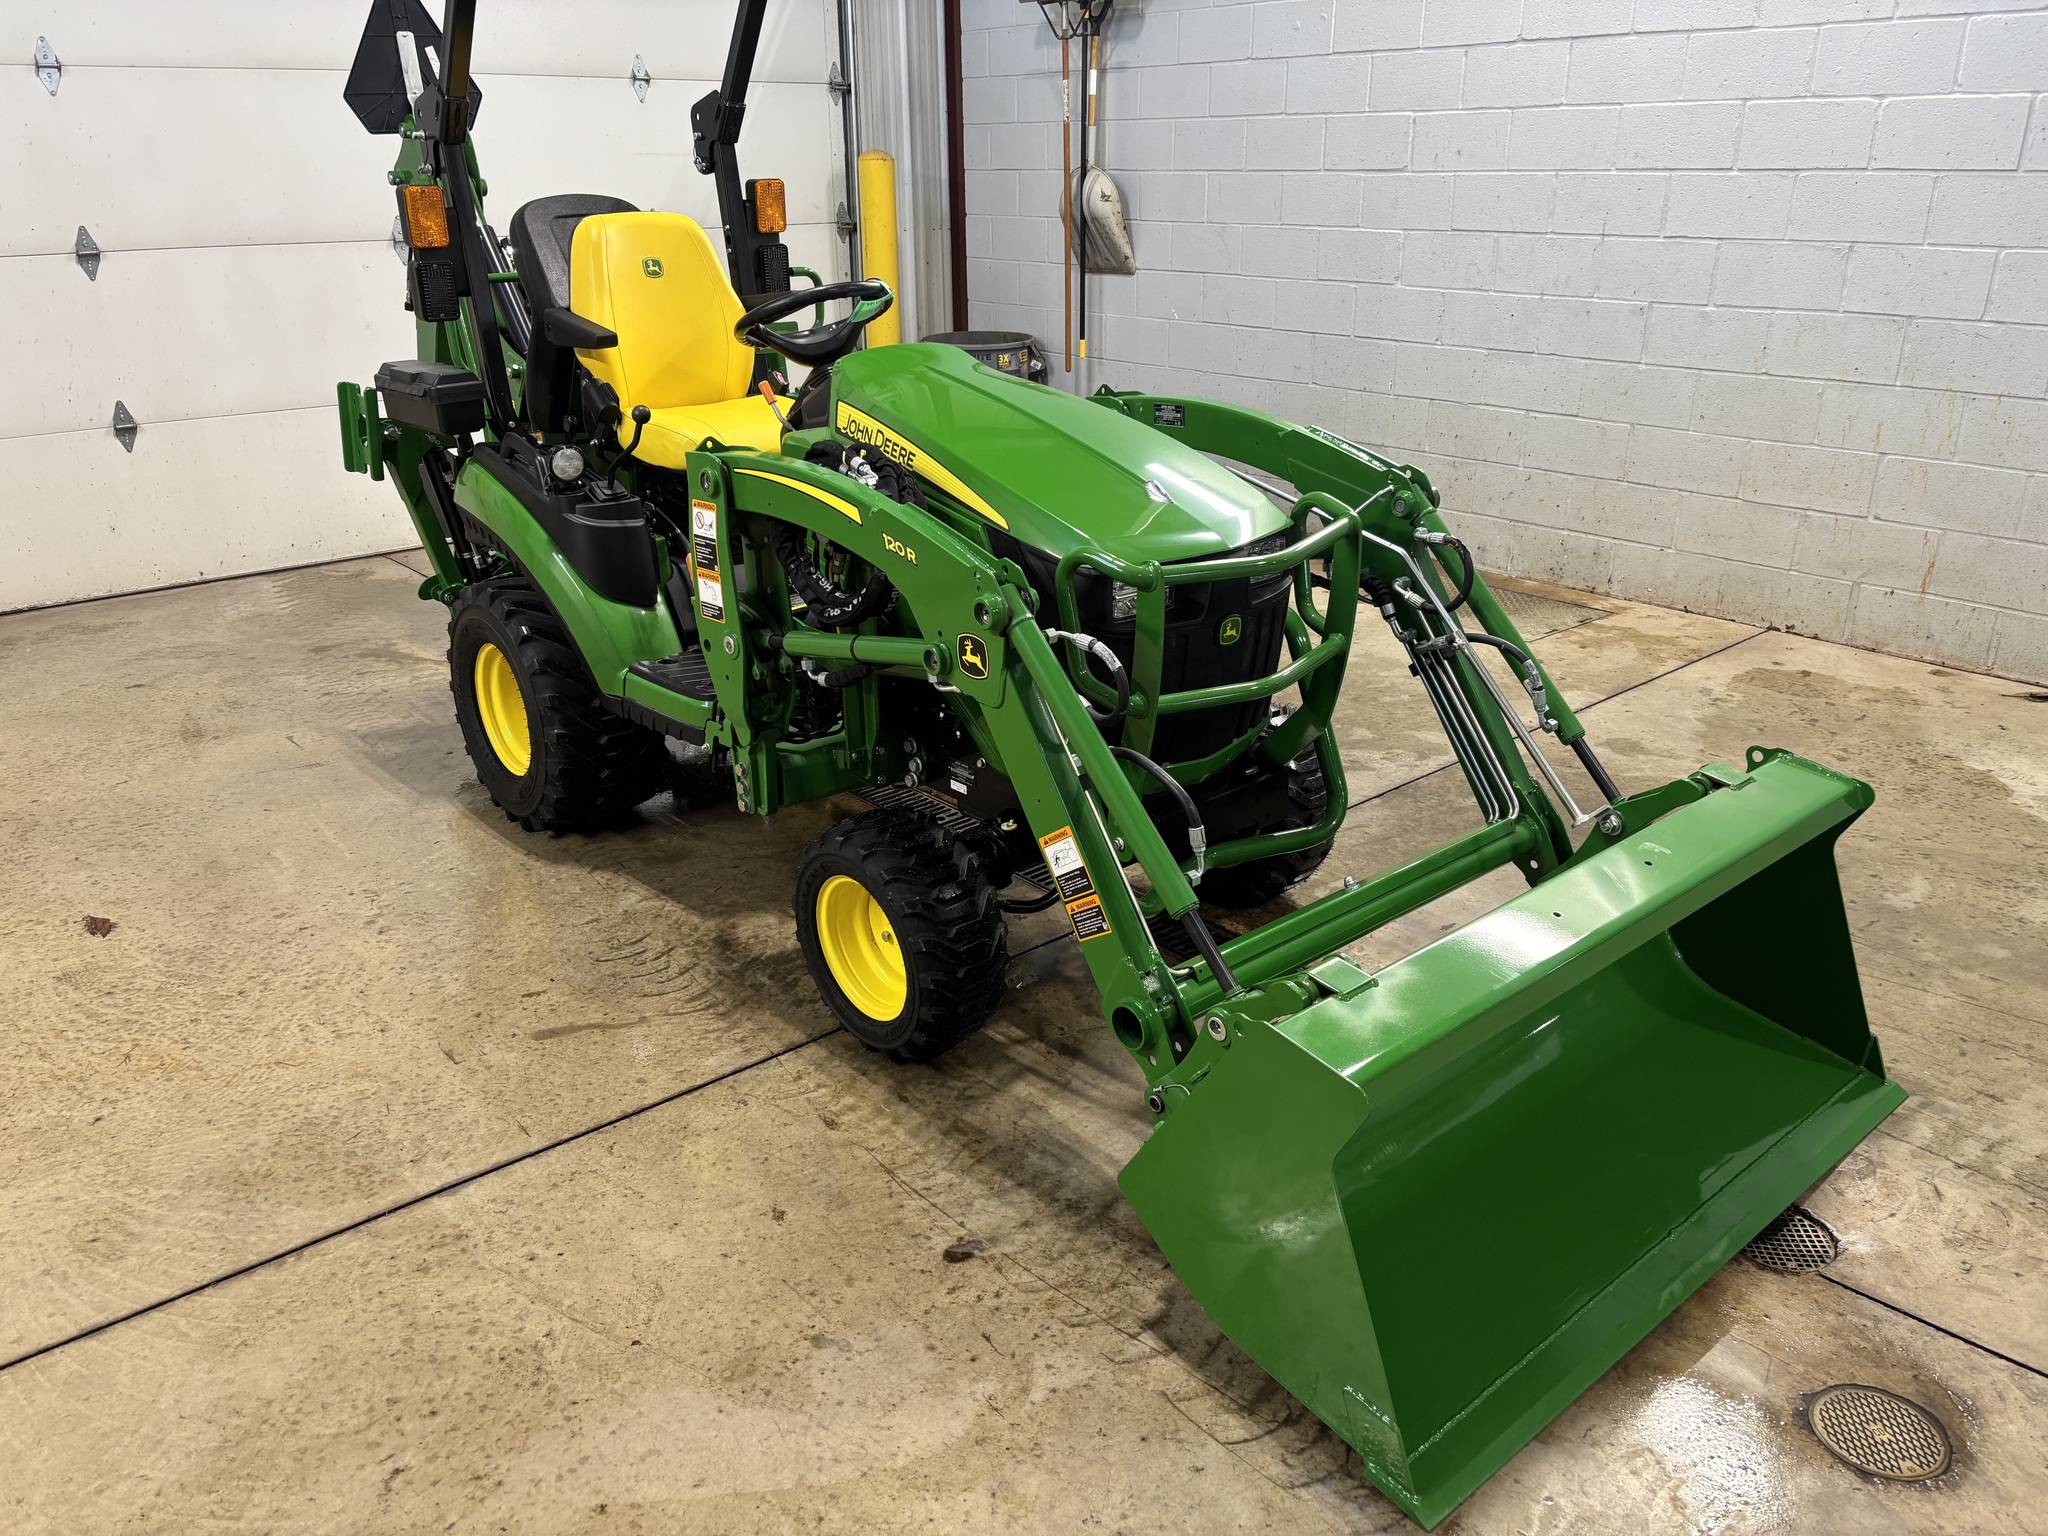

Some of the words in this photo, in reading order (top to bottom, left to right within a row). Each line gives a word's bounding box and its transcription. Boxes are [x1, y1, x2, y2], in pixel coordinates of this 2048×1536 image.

[998, 354, 1009, 363] 3X
[842, 413, 873, 444] JOHN
[874, 429, 917, 470] DEERE
[696, 502, 715, 511] WARNING
[701, 572, 720, 583] WARNING
[1047, 829, 1069, 843] WARNING
[1075, 898, 1097, 910] WARNING
